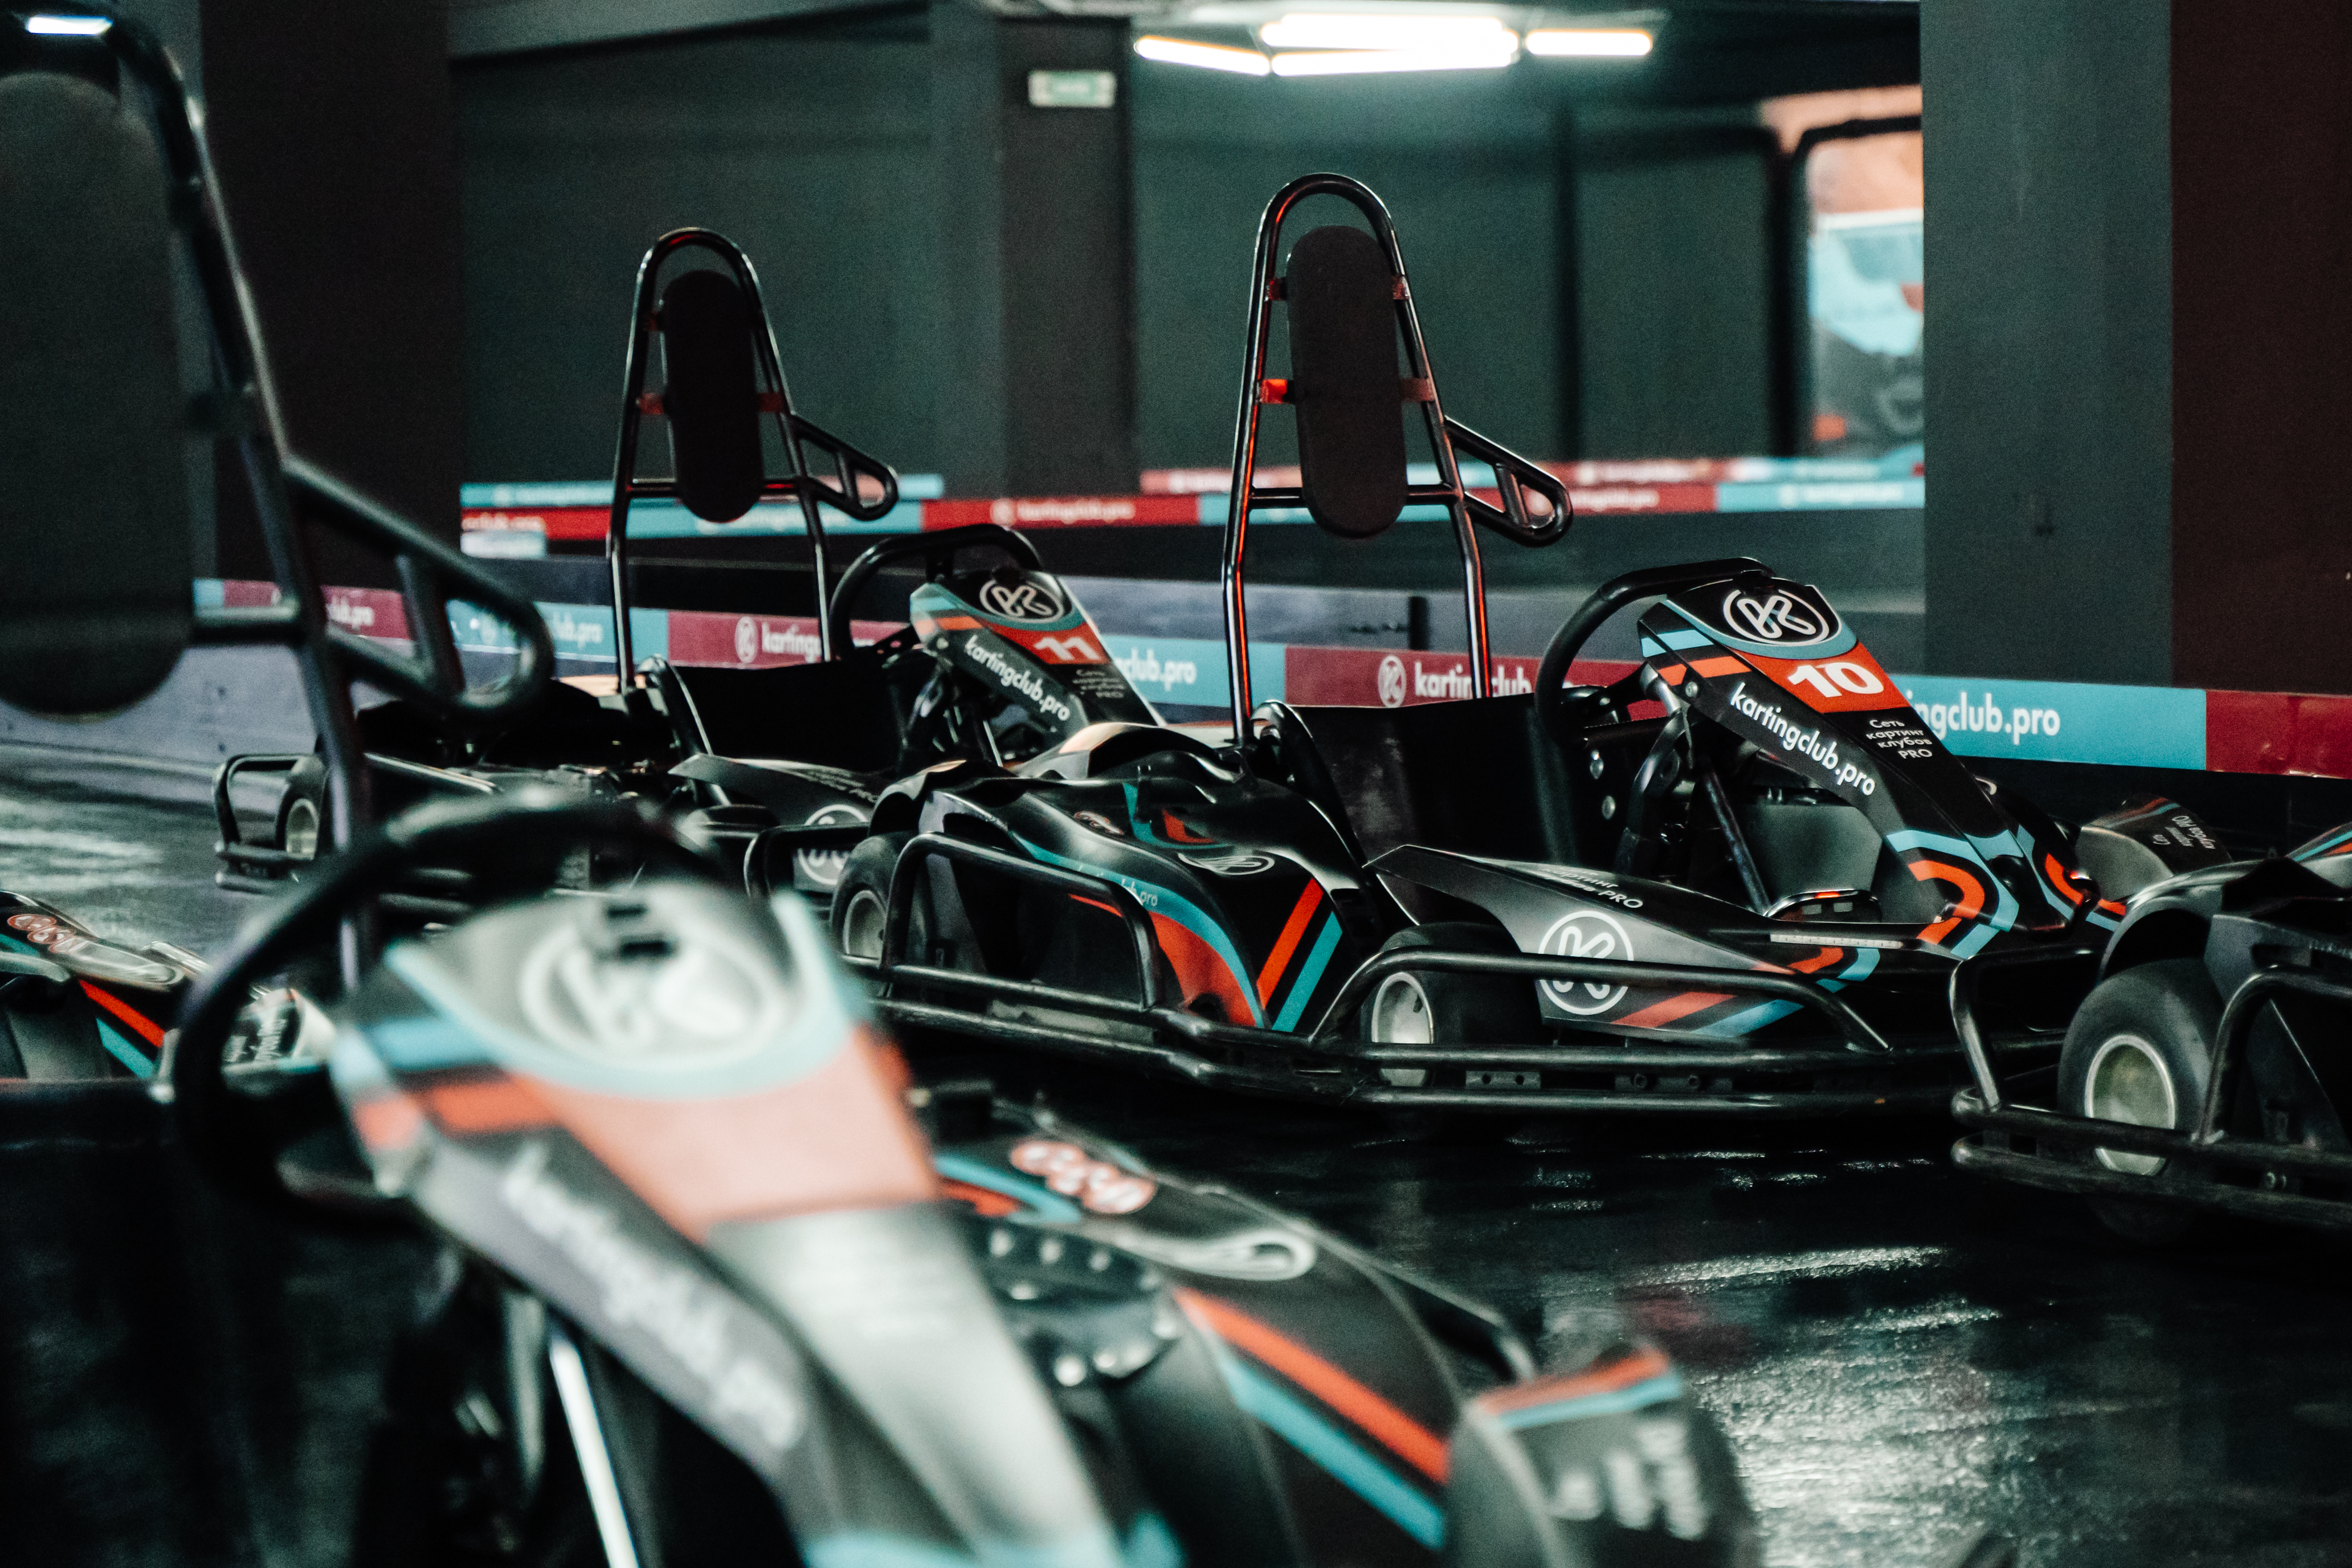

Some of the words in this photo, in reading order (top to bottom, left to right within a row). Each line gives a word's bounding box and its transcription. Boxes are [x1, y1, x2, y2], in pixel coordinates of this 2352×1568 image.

[1034, 636, 1103, 661] 11
[965, 634, 1070, 721] kartingclub.pro
[1787, 662, 1884, 698] 10
[1869, 720, 1905, 728] Сеть
[1906, 689, 2060, 745] ngclub.pro
[1730, 682, 1875, 795] kartingclub.pro
[1866, 730, 1924, 740] картинг
[1877, 737, 1933, 748] клубов
[1897, 749, 1933, 759] PRO
[1598, 889, 1644, 909] PRO
